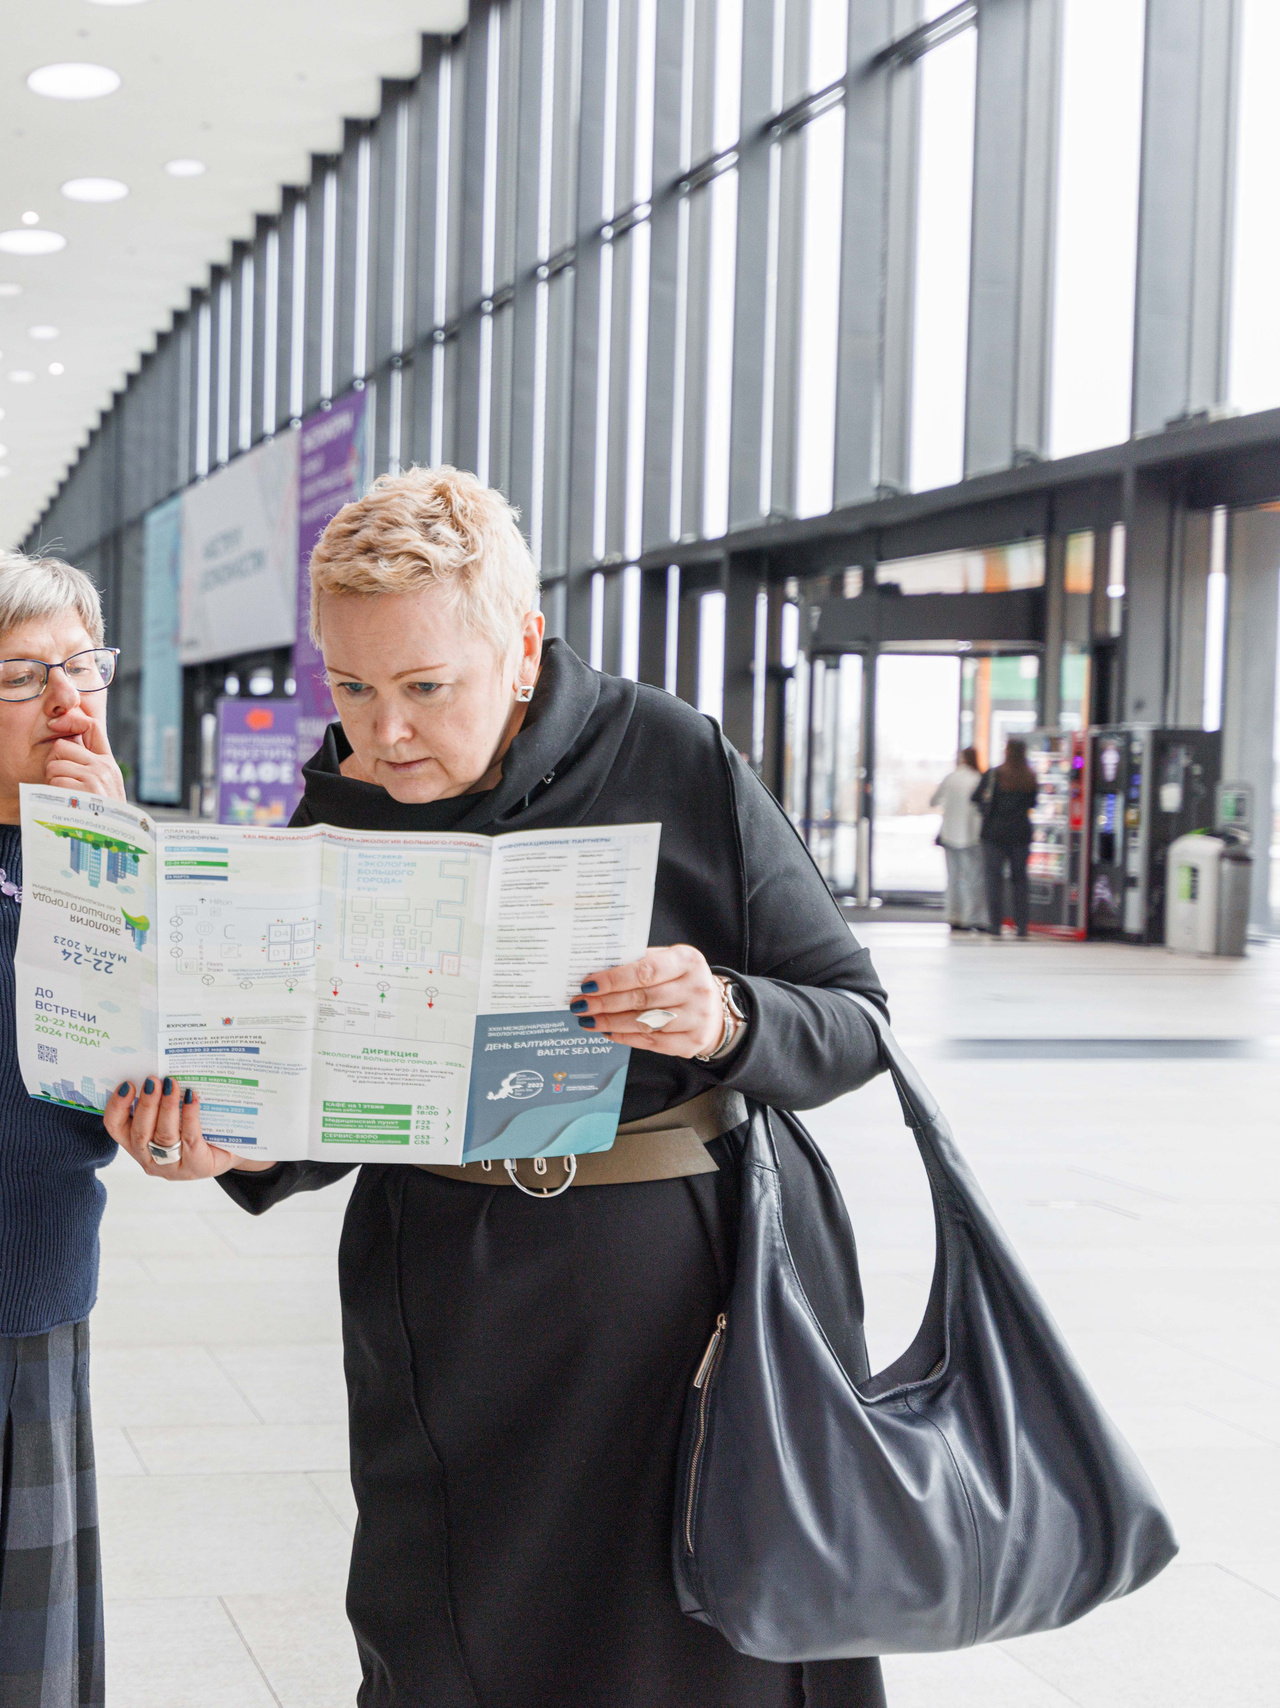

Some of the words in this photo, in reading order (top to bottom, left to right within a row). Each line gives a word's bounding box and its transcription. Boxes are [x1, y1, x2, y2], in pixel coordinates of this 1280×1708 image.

[221, 761, 295, 785] КАФЕ
[258, 831, 326, 841] МЕЖДУНАРОДНЫЙ
[326, 832, 355, 842] ФОРУМ
[356, 837, 402, 845] «ЭКОЛОГИЯ
[448, 840, 485, 848] ГОРОДА»
[498, 839, 570, 850] ИНФОРМАЦИОННЫЕ
[571, 837, 611, 845] ПАРТНЕРЫ
[358, 861, 417, 869] «ЭКОЛОГИЯ
[357, 868, 415, 876] БОЛЬШОГО
[356, 877, 402, 885] ГОРОДА»
[32, 891, 69, 909] ГОРОДА
[209, 898, 233, 906] Hilton
[70, 902, 122, 925] БОЛЬШОГО
[70, 914, 122, 936] ЭКОЛОГИЯ
[274, 930, 289, 938] D4
[297, 927, 311, 936] D3
[53, 935, 81, 950] 2023
[84, 944, 128, 963] МАРТА
[295, 946, 310, 955] D2
[34, 986, 54, 999] ДО
[34, 999, 97, 1024] ВСТРЕЧИ
[34, 1013, 65, 1028] 20-22
[68, 1022, 111, 1040] МАРТА
[503, 1021, 565, 1031] МЕЖДУНАРОДНЫЙ
[34, 1024, 62, 1038] 2024
[65, 1032, 101, 1048] ГОДА!
[487, 1028, 544, 1038] ЭКОЛОГИЧЕСКИЙ
[484, 1042, 513, 1052] ДЕНЬ
[513, 1037, 587, 1050] БАЛТИЙСКОГО
[588, 1036, 615, 1045] МОР
[318, 1050, 362, 1061] «ЭКОЛОГИИ
[363, 1054, 406, 1064] БОЛЬШОГО
[407, 1058, 438, 1066] ГОРОДА
[361, 1047, 419, 1059] ДИРЕКЦИЯ
[536, 1048, 570, 1057] BALTIC
[571, 1046, 591, 1055] SEA
[592, 1046, 613, 1054] DAY
[333, 1067, 363, 1075] получить
[364, 1070, 409, 1078] закрывающие
[361, 1064, 394, 1072] дирекции
[324, 1117, 376, 1126] Медицинский
